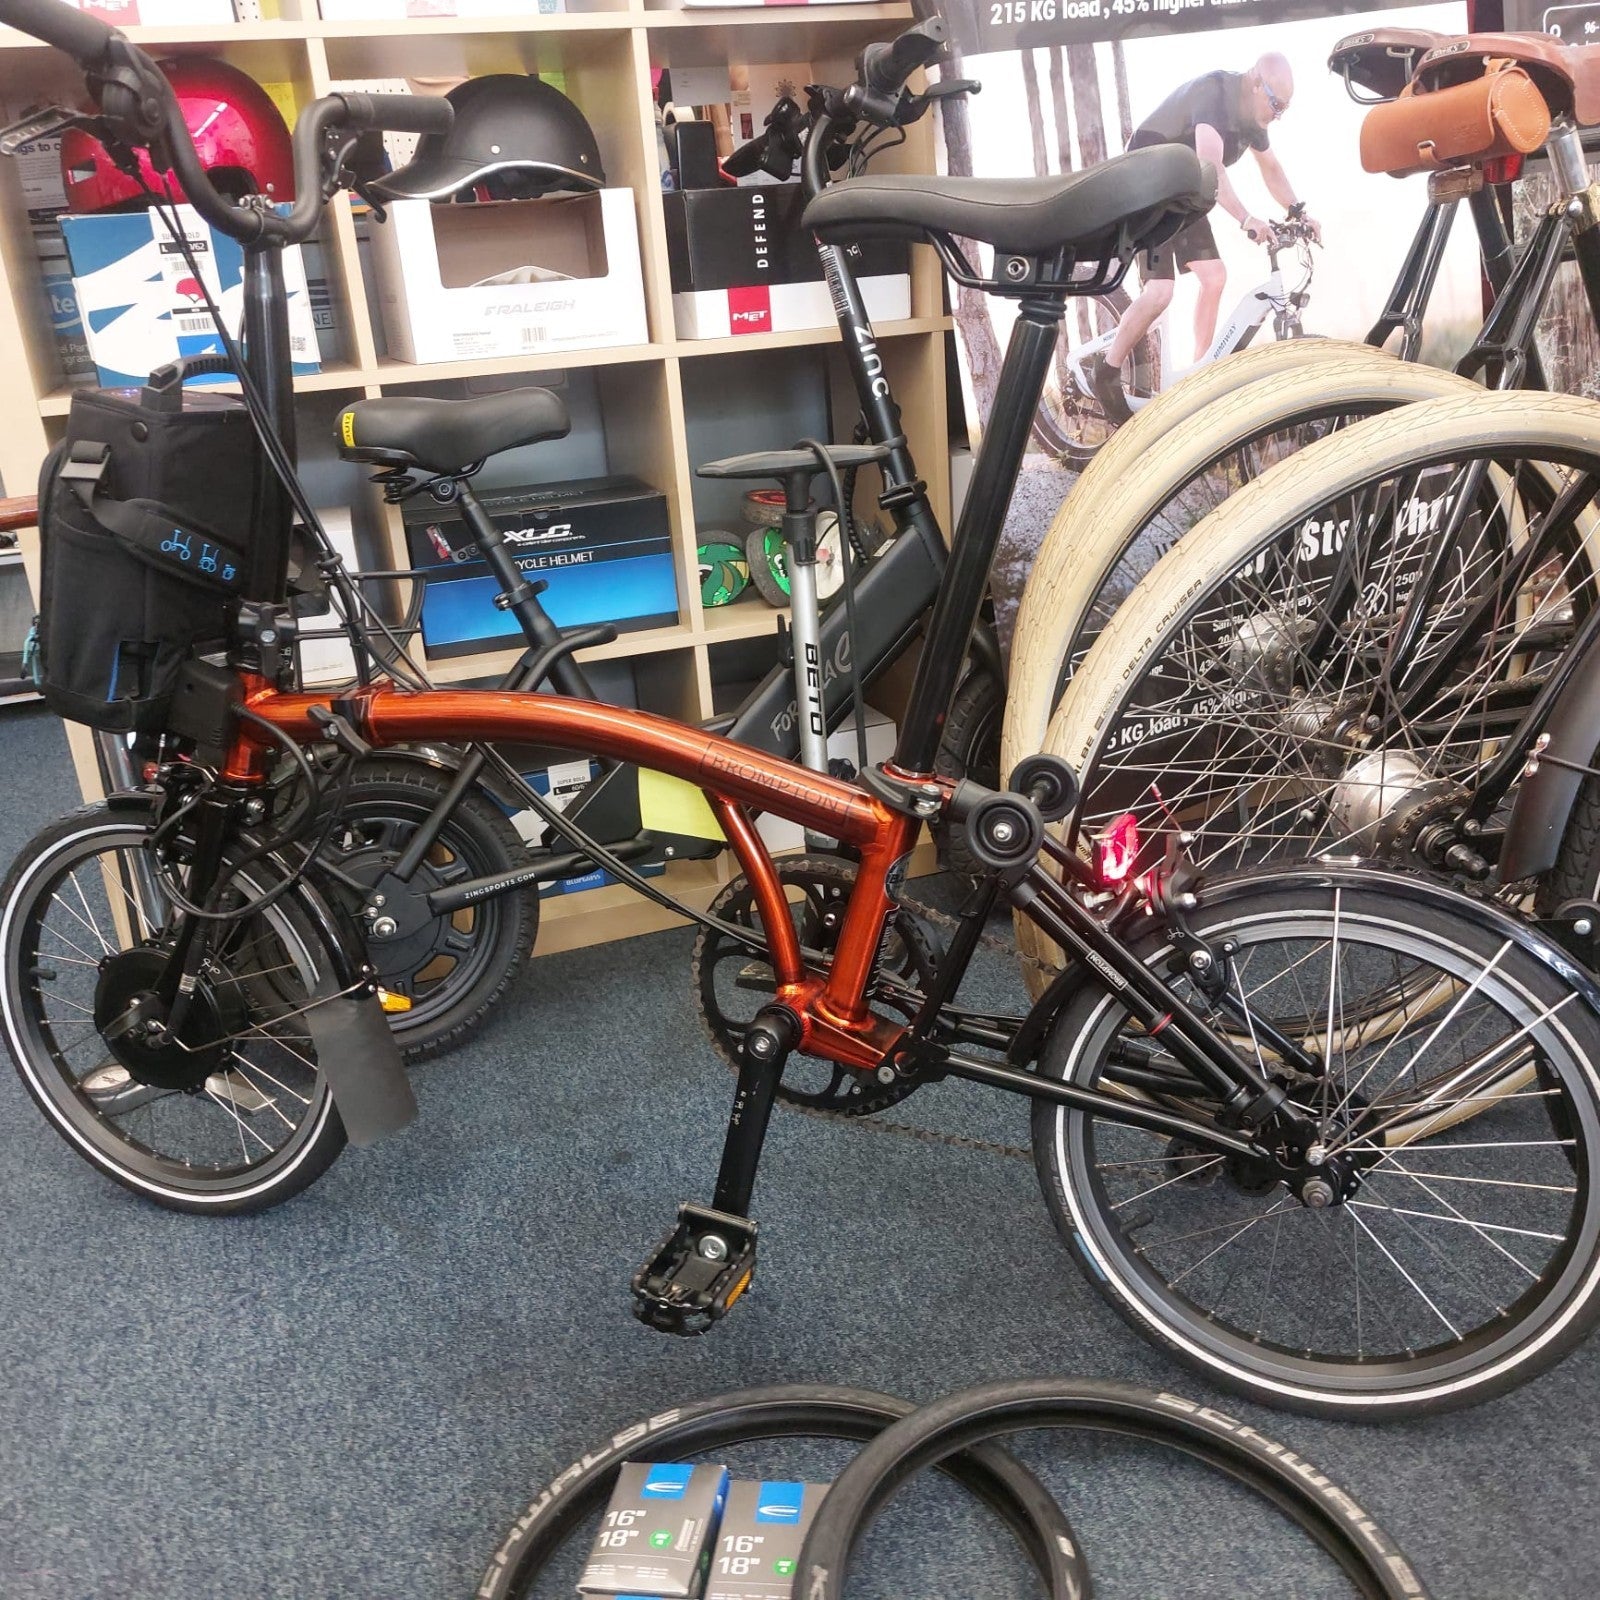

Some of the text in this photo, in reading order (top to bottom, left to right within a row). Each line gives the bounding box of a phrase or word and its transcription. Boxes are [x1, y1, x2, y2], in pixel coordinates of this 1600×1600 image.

[990, 2, 1026, 25] 215
[1030, 0, 1056, 21] KG
[752, 194, 769, 269] DEFEND
[732, 310, 768, 322] MET
[503, 523, 572, 544] XLC
[550, 551, 594, 567] HELMET
[1122, 636, 1152, 681] DELTA
[1155, 578, 1202, 634] CRUISER
[805, 643, 823, 736] BETO
[1121, 723, 1144, 746] KG
[710, 752, 842, 811] BROMPTON
[1089, 954, 1125, 987] BROMPTON
